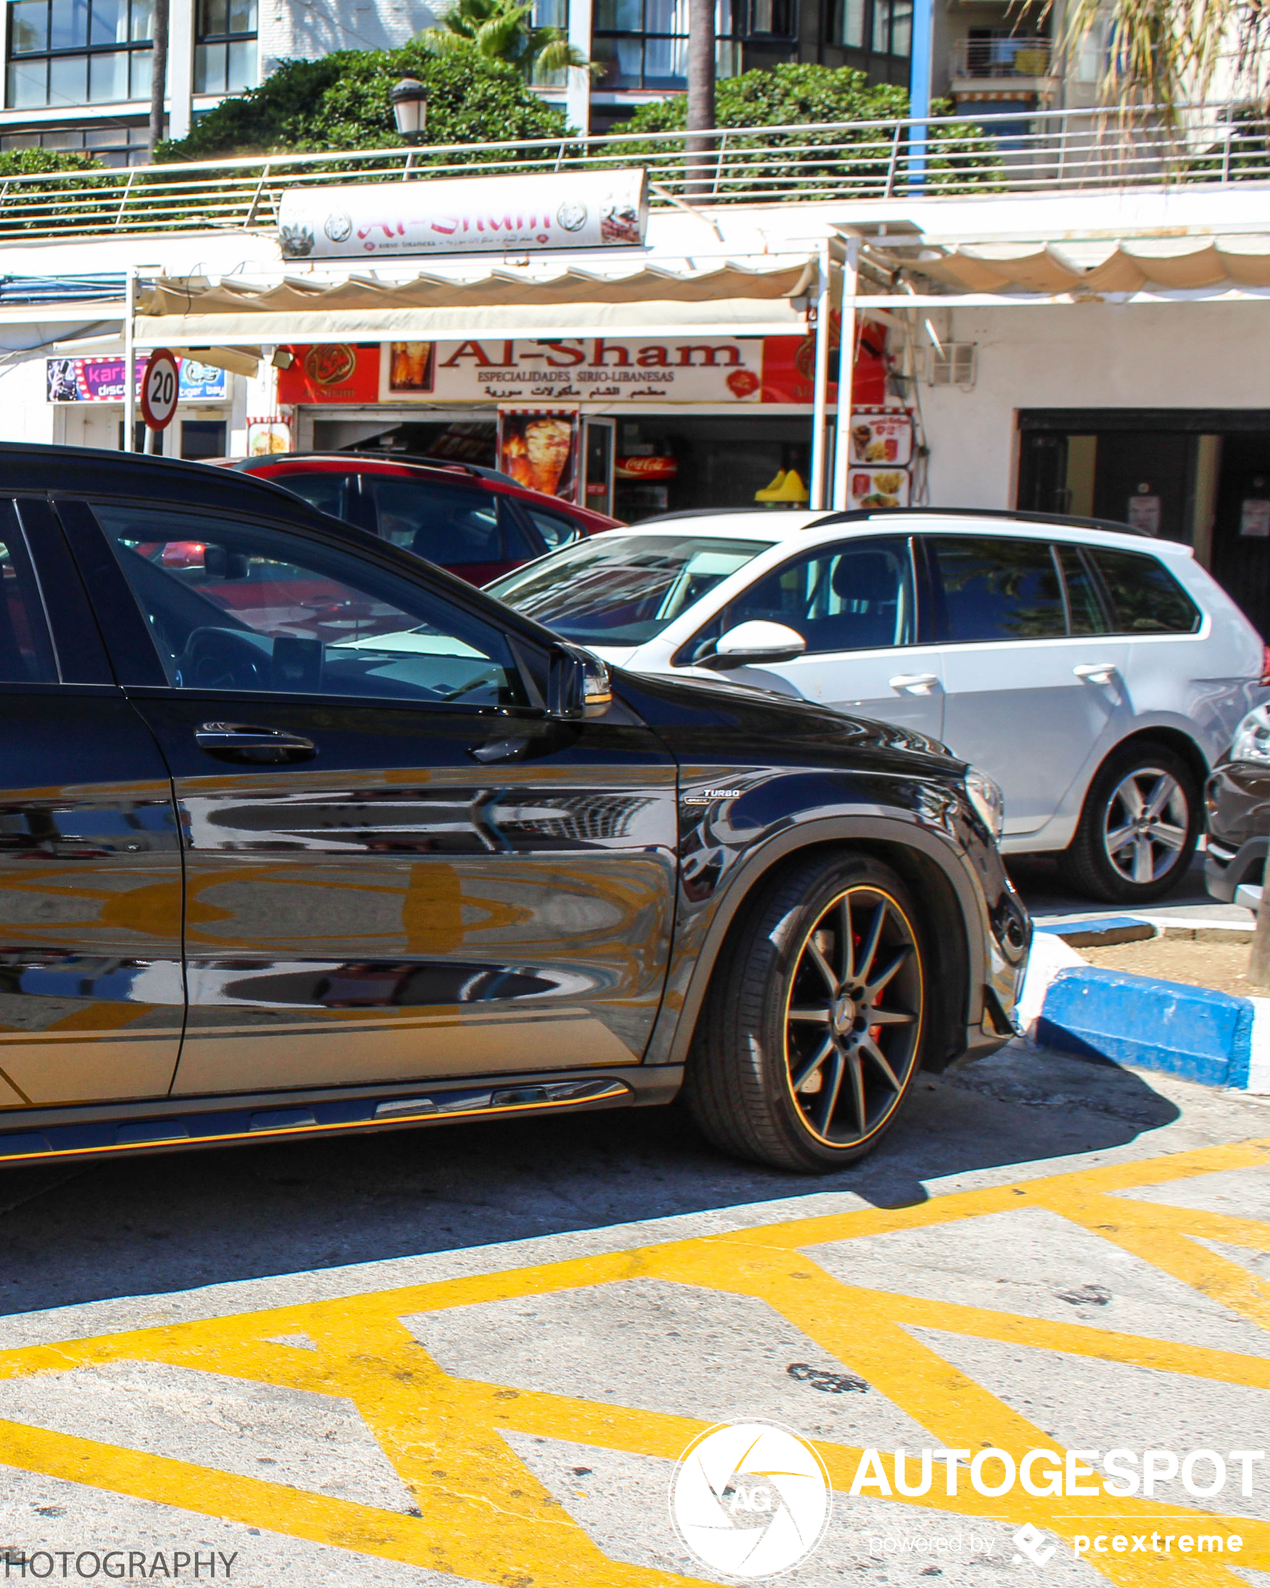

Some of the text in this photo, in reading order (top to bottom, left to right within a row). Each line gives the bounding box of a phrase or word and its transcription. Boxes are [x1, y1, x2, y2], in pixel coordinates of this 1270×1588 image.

[477, 370, 674, 382] ESPECIALIDADES SIRIO-LIBANESAS
[151, 371, 174, 405] 20
[704, 789, 740, 797] TURBO
